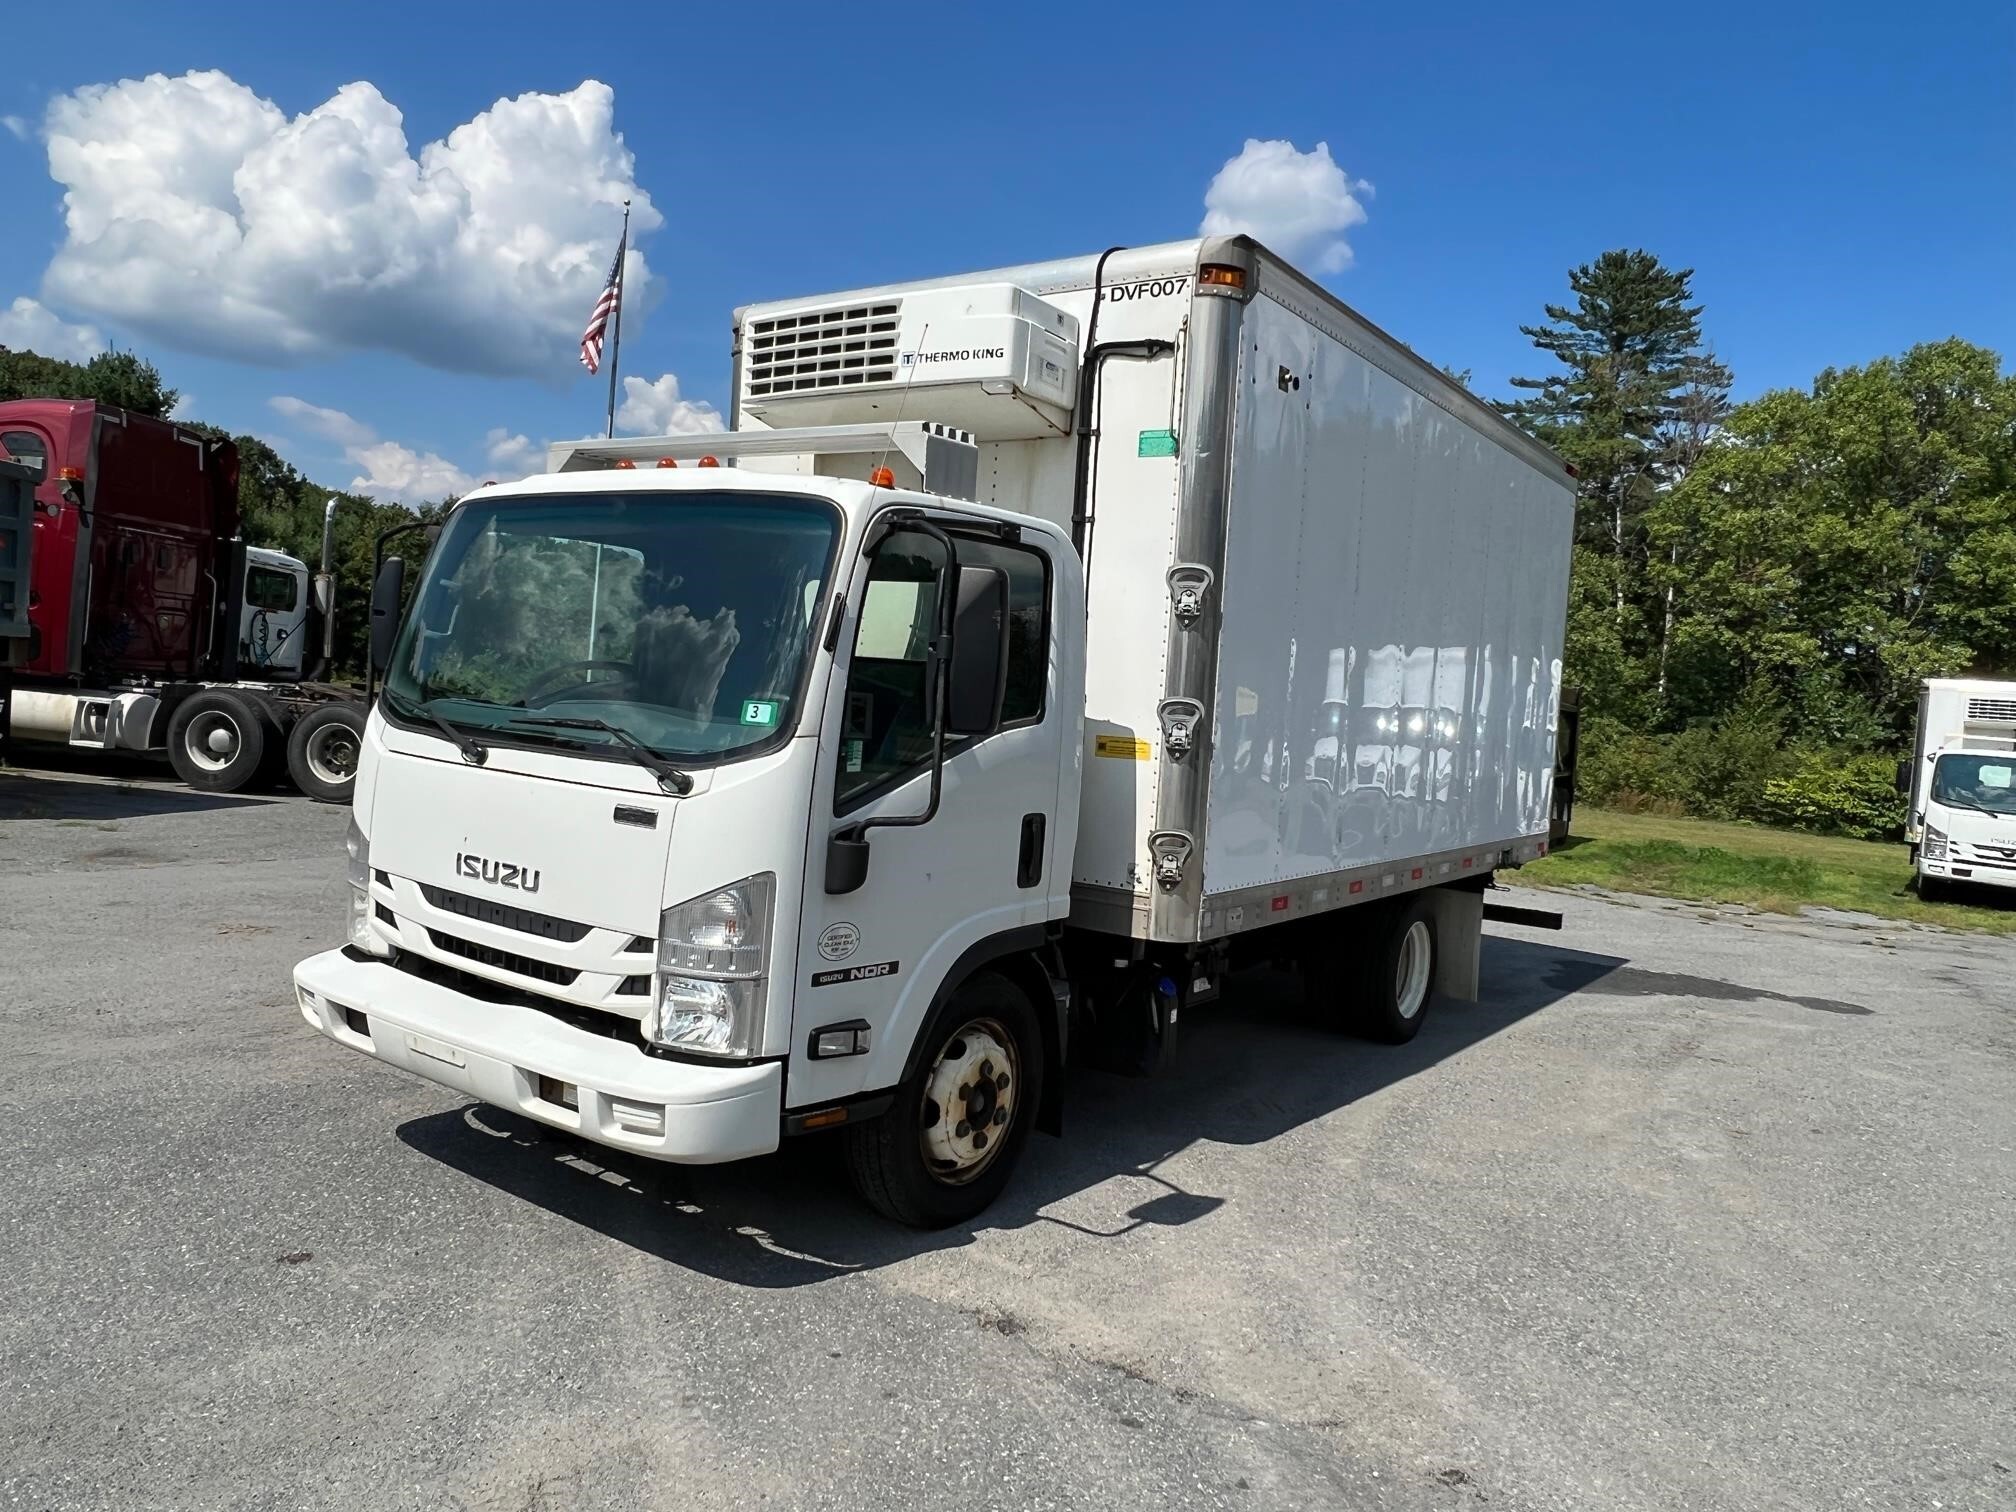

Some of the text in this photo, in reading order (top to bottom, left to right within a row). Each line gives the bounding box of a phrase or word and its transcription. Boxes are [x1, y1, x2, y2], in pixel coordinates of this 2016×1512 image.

[1110, 278, 1187, 303] DVF007
[917, 350, 970, 363] THERMO
[972, 347, 1004, 360] KING
[750, 705, 759, 719] 3
[456, 852, 540, 894] ISUZU
[819, 973, 844, 983] ISUZU
